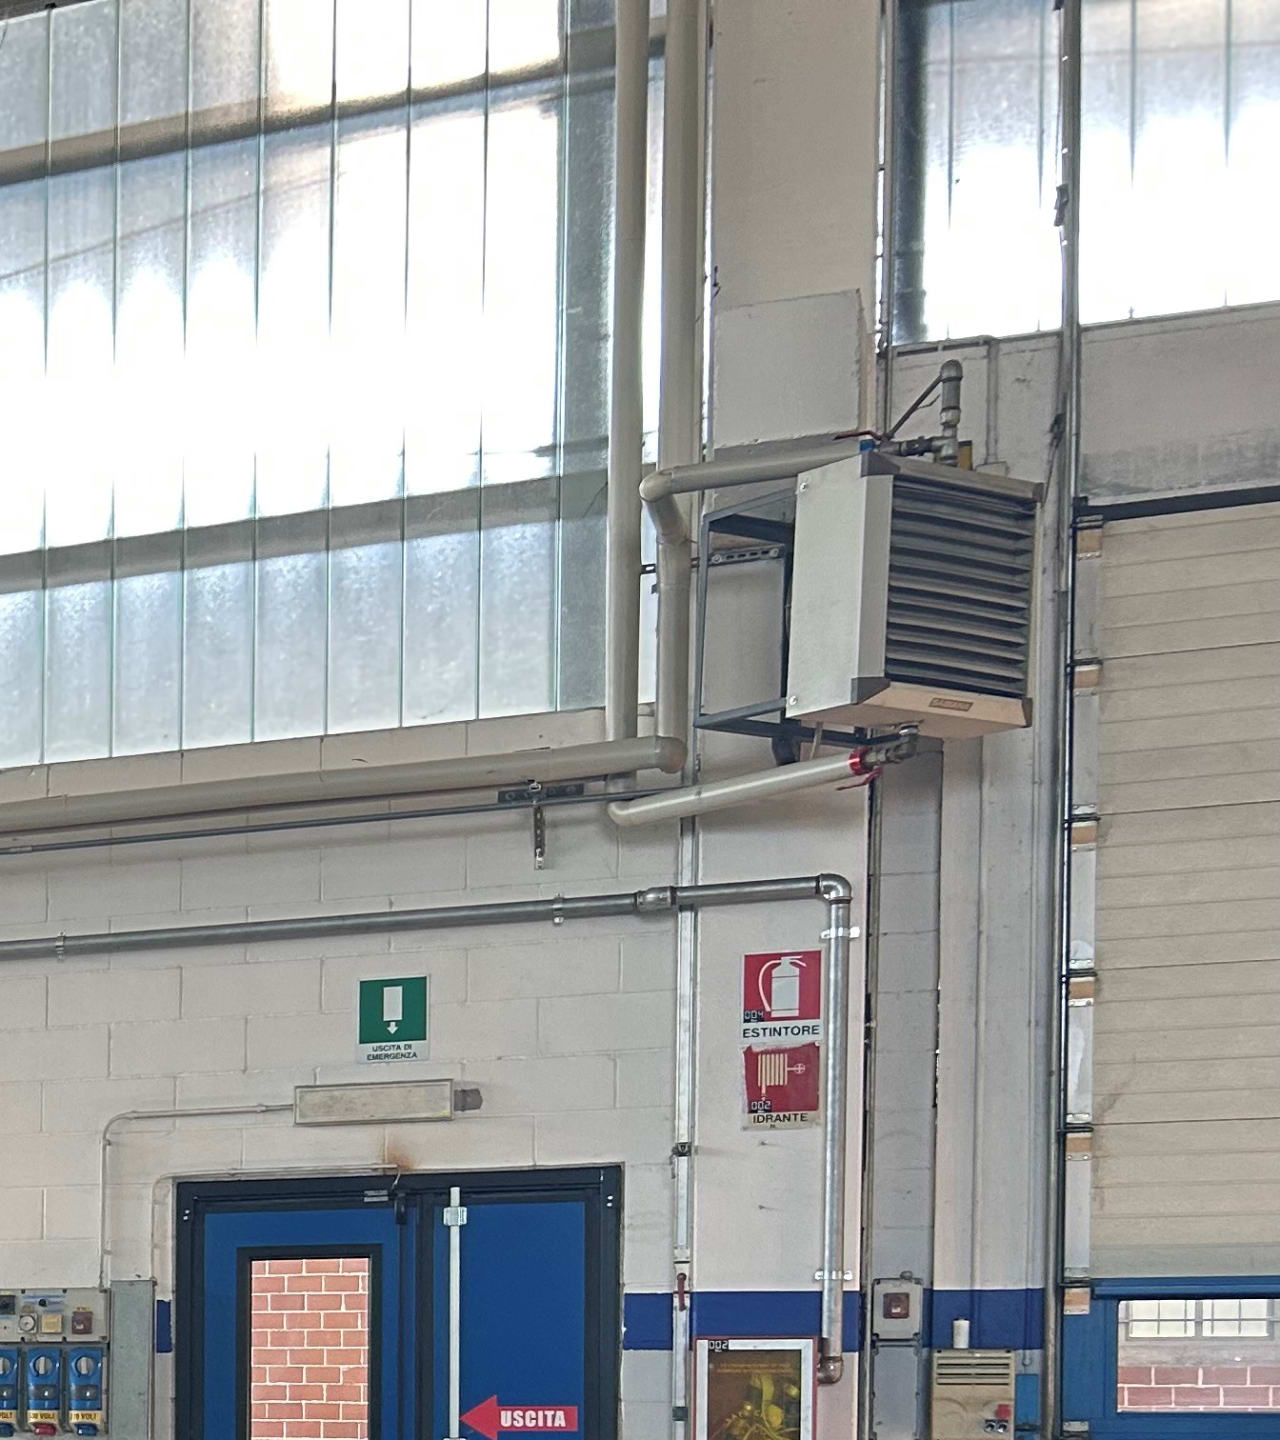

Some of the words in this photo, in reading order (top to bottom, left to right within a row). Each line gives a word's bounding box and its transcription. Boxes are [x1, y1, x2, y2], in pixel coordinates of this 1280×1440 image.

[742, 1024, 820, 1039] ESTINTORE
[371, 1043, 401, 1052] USCITA
[403, 1043, 412, 1051] DI
[366, 1051, 418, 1061] EMERGENZA
[752, 1112, 809, 1124] IDRANTE
[500, 1409, 566, 1428] USCITA
